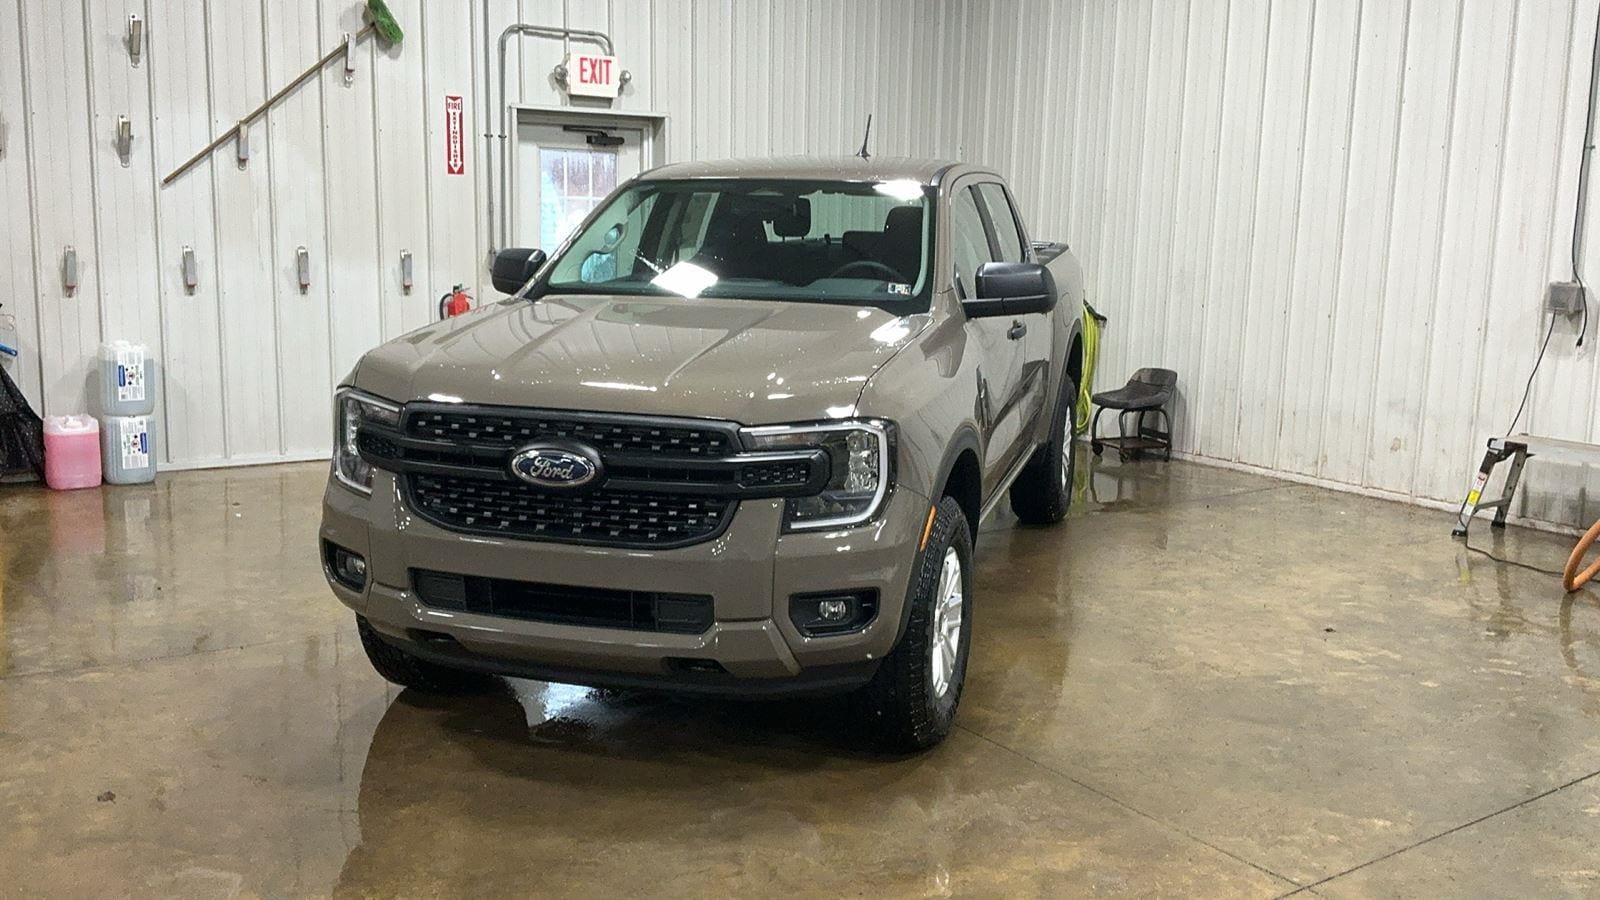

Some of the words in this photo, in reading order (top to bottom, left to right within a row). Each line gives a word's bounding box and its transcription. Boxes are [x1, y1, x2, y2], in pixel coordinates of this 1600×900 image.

[579, 57, 612, 85] EXIT
[448, 102, 461, 110] FIRE
[530, 456, 575, 480] Ford
